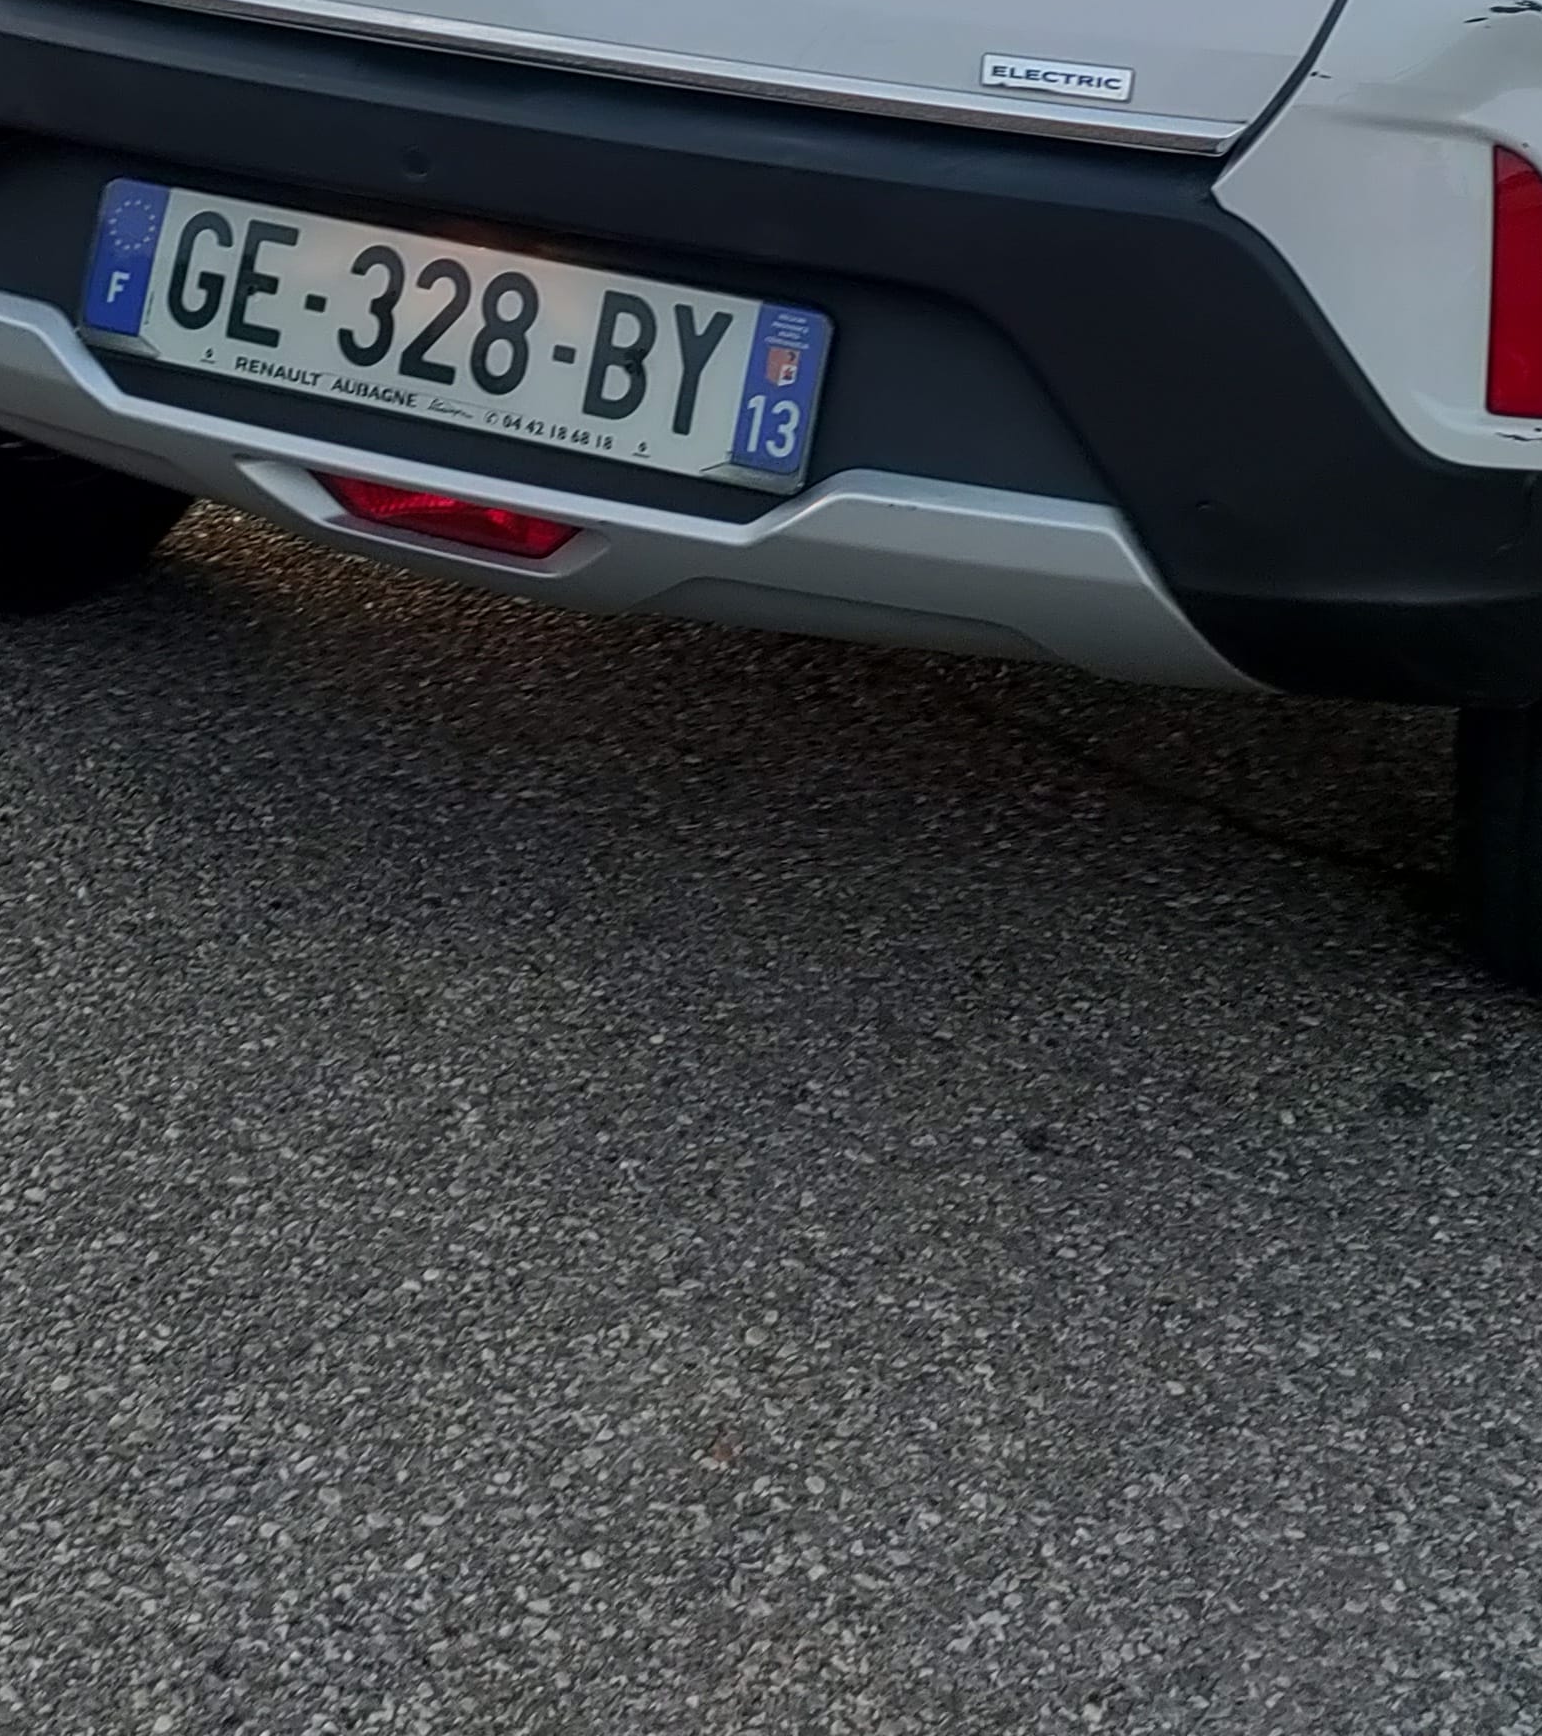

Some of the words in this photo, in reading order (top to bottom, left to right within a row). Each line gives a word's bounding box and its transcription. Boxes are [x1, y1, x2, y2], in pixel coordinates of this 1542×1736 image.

[991, 64, 1123, 91] ELECTRIC
[106, 270, 132, 304] F
[166, 210, 734, 437] GE-328-BY
[234, 355, 323, 387] RENAULT
[330, 376, 419, 409] AUBAGNE
[525, 418, 545, 436] 42
[746, 394, 801, 459] 13
